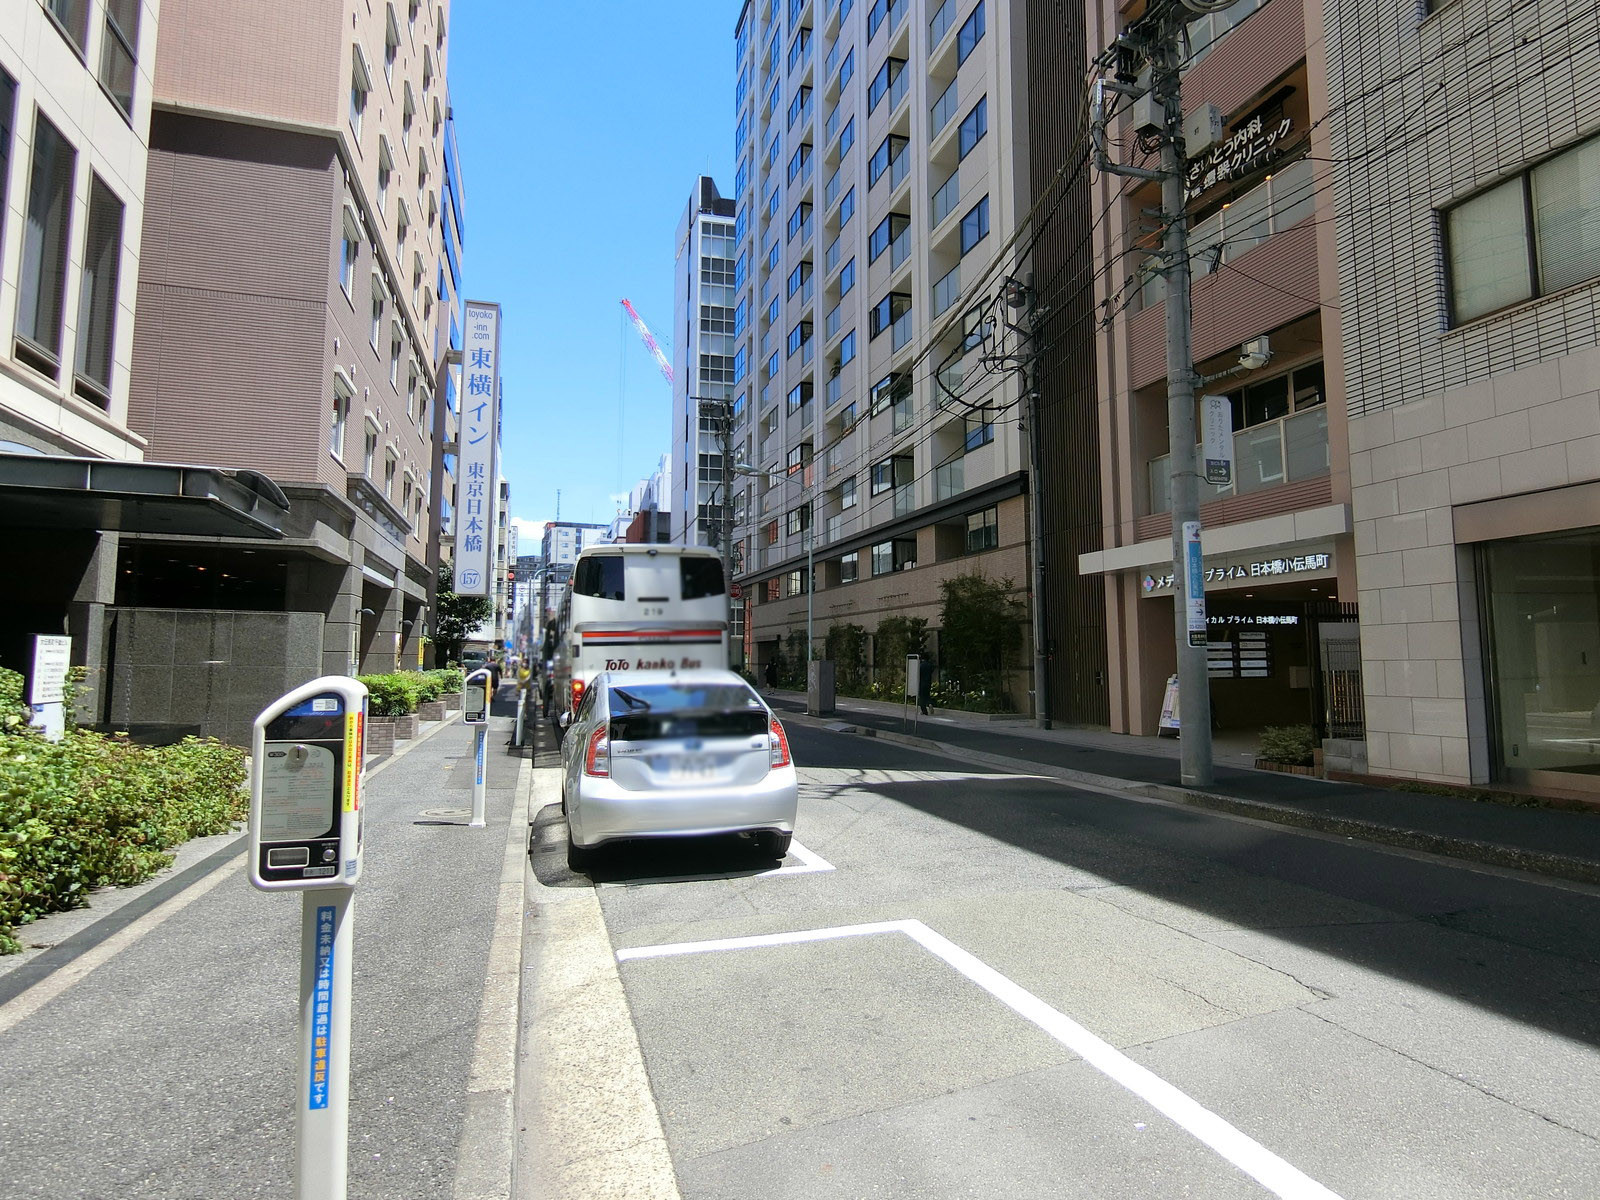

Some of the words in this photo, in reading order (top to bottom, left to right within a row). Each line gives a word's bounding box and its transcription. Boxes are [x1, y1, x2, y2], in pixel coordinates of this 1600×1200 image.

[468, 309, 493, 320] toyoko
[471, 332, 490, 341] .com
[468, 348, 492, 445] 東横イン
[464, 462, 484, 552] 東京日本橋
[1205, 567, 1246, 582] プライム
[1250, 554, 1329, 577] 日本橋小伝馬町
[461, 571, 479, 586] 157
[1205, 616, 1224, 624] ィカル
[1227, 615, 1254, 624] プライム
[1256, 615, 1298, 625] 日本橋小伝馬町
[605, 659, 630, 671] ToTo
[636, 657, 676, 671] kanko
[681, 657, 702, 670] Bus
